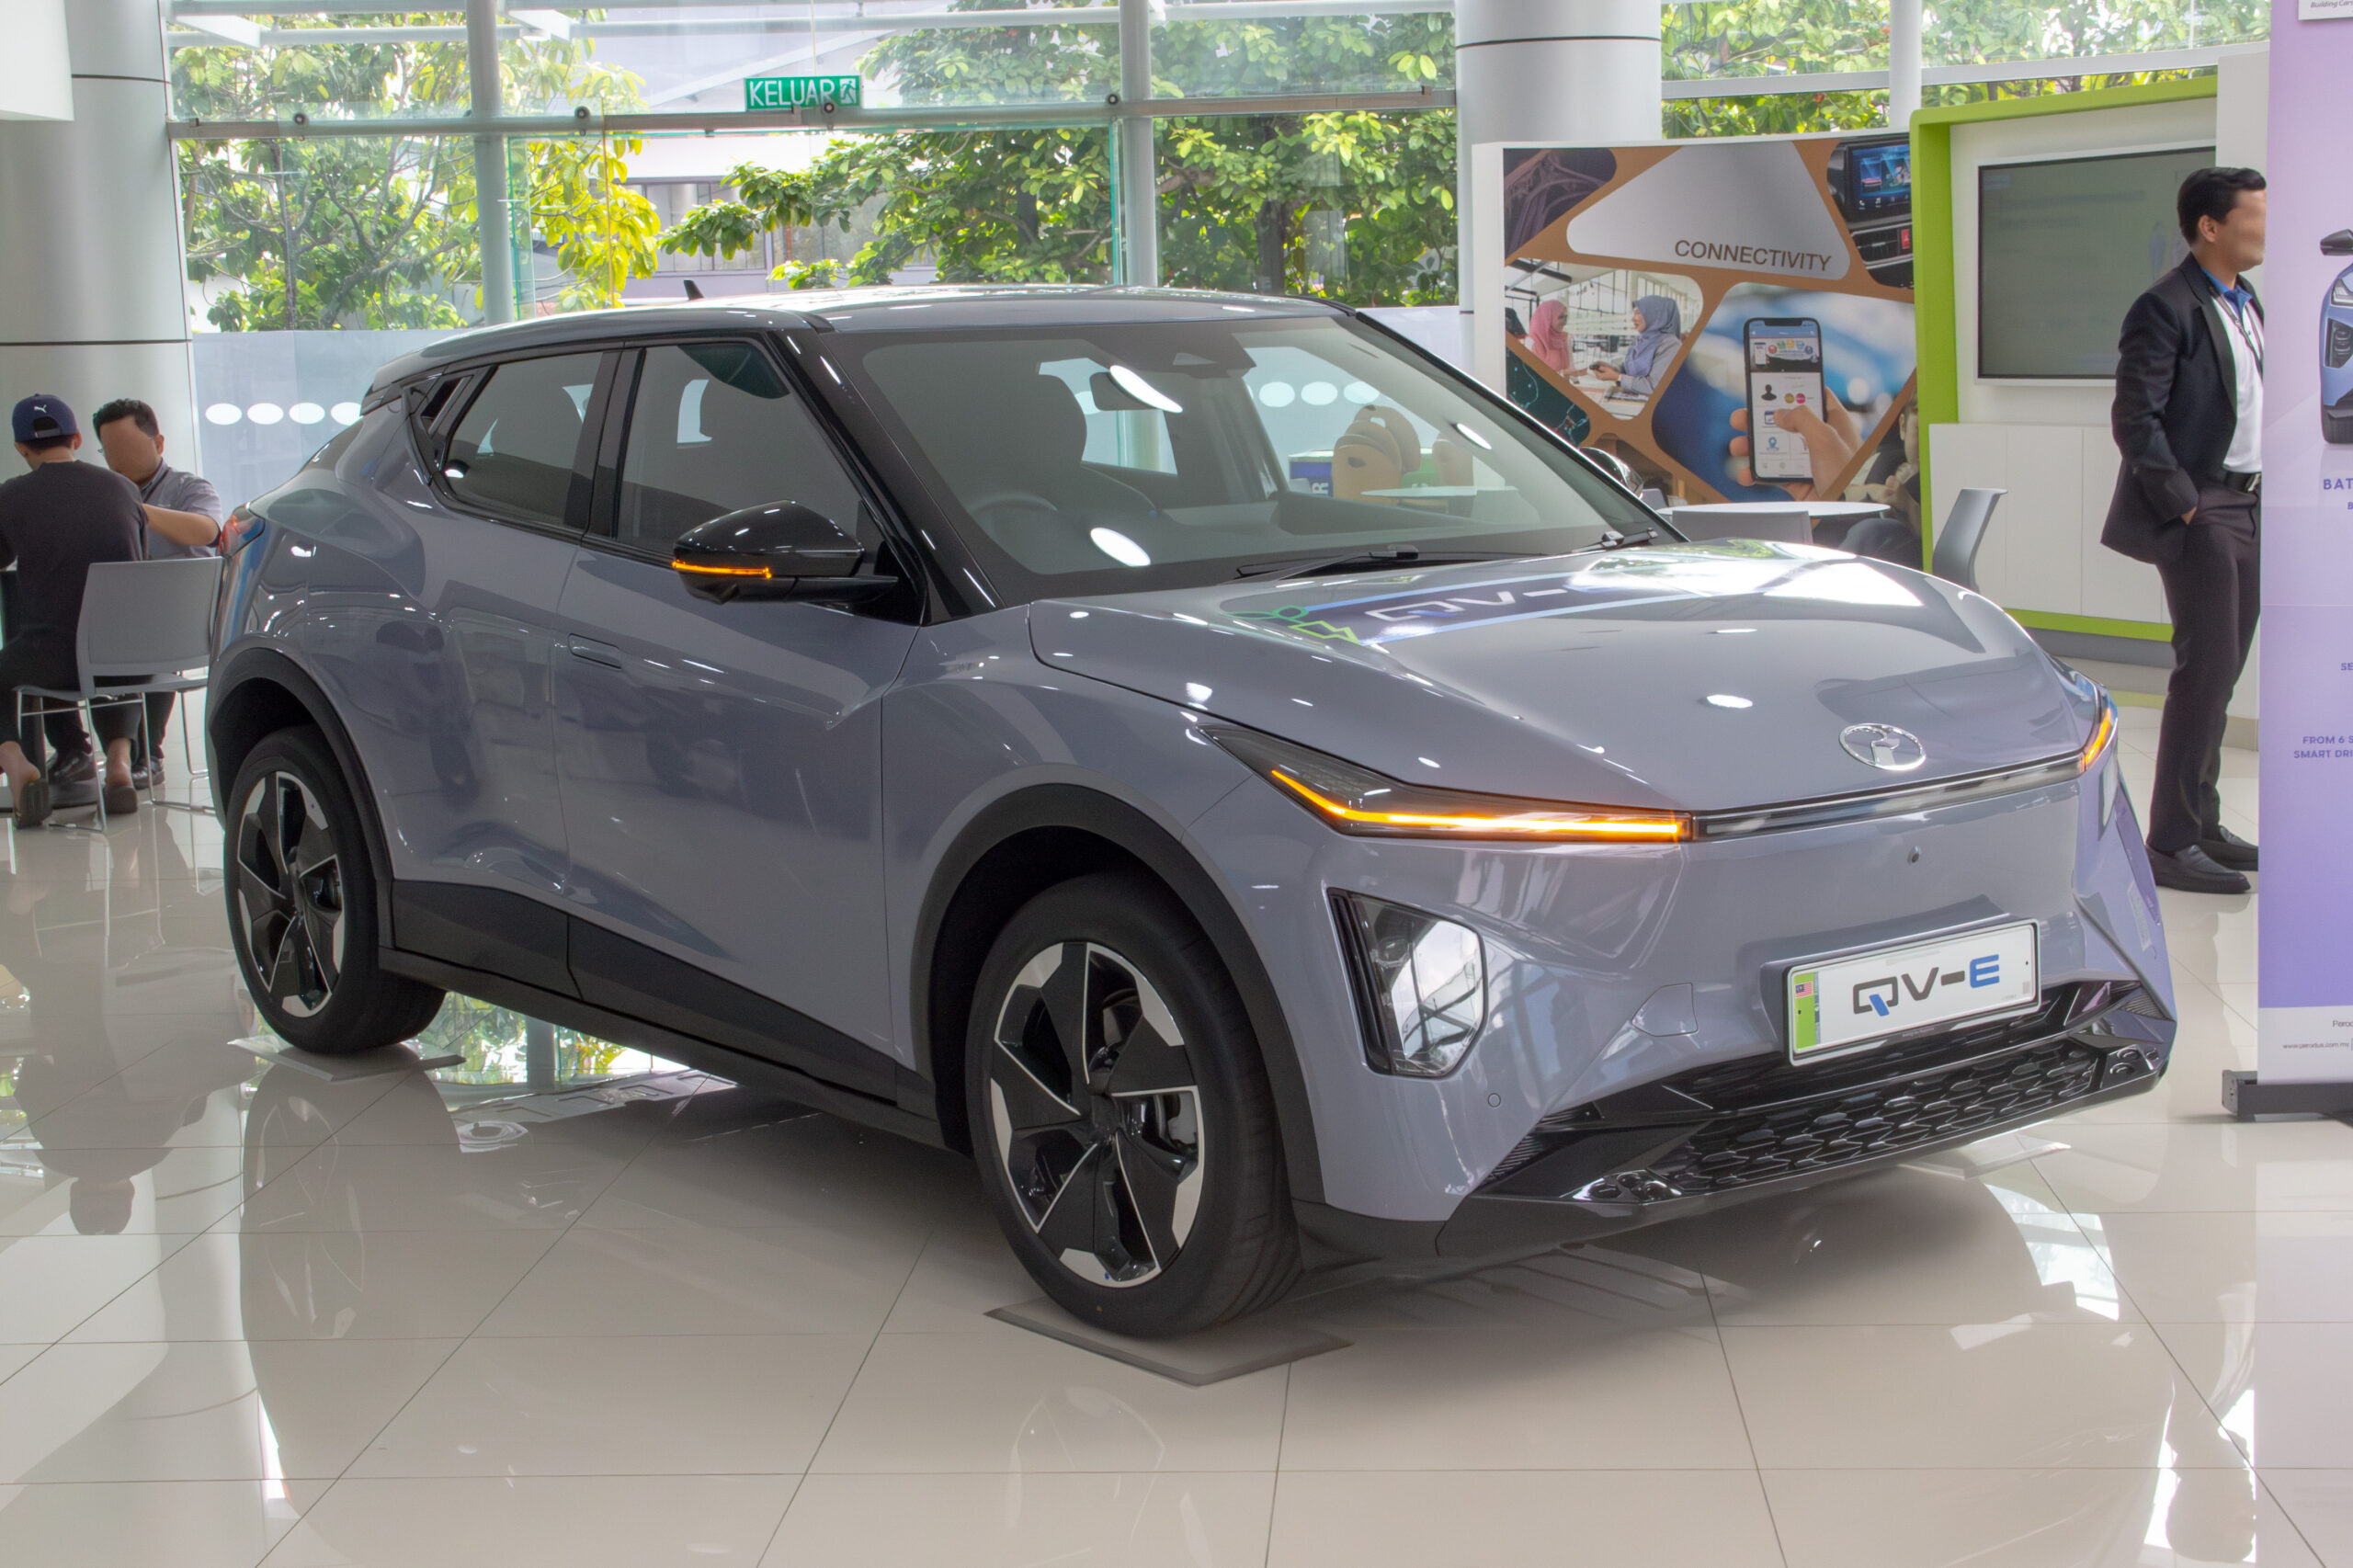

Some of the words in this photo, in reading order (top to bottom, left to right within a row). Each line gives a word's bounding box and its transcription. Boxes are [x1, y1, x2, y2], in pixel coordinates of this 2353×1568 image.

[749, 79, 835, 107] KELUAR
[1675, 240, 1832, 272] CONNECTIVITY
[2324, 478, 2353, 490] BAT
[2294, 750, 2331, 758] SMART
[1852, 953, 2000, 1017] QV-E
